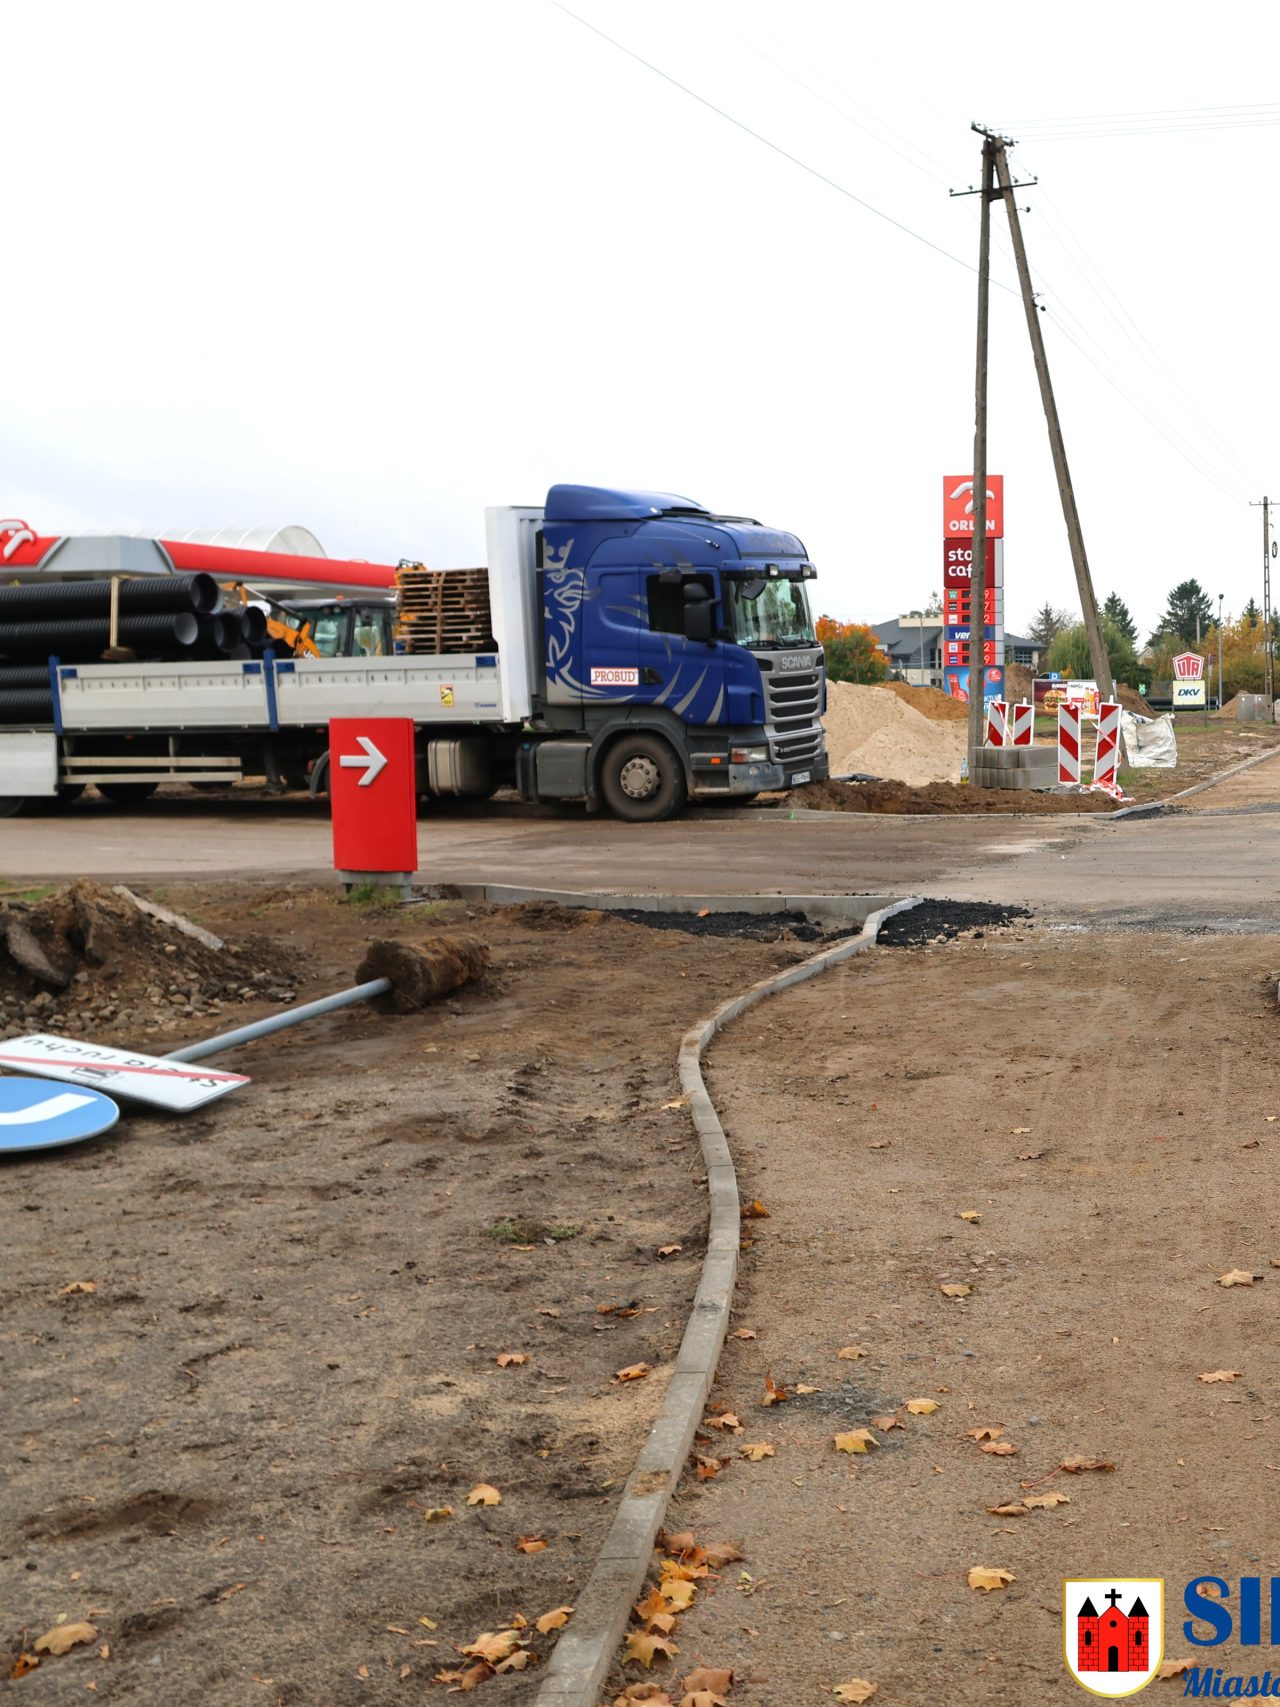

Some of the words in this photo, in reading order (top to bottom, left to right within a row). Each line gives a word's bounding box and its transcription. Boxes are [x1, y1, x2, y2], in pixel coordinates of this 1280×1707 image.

[949, 520, 996, 531] ORLN
[948, 563, 973, 578] caf
[781, 656, 812, 669] SCANIA
[1176, 656, 1201, 677] UTA
[1177, 688, 1200, 697] DKV
[23, 1038, 117, 1061] ruchu
